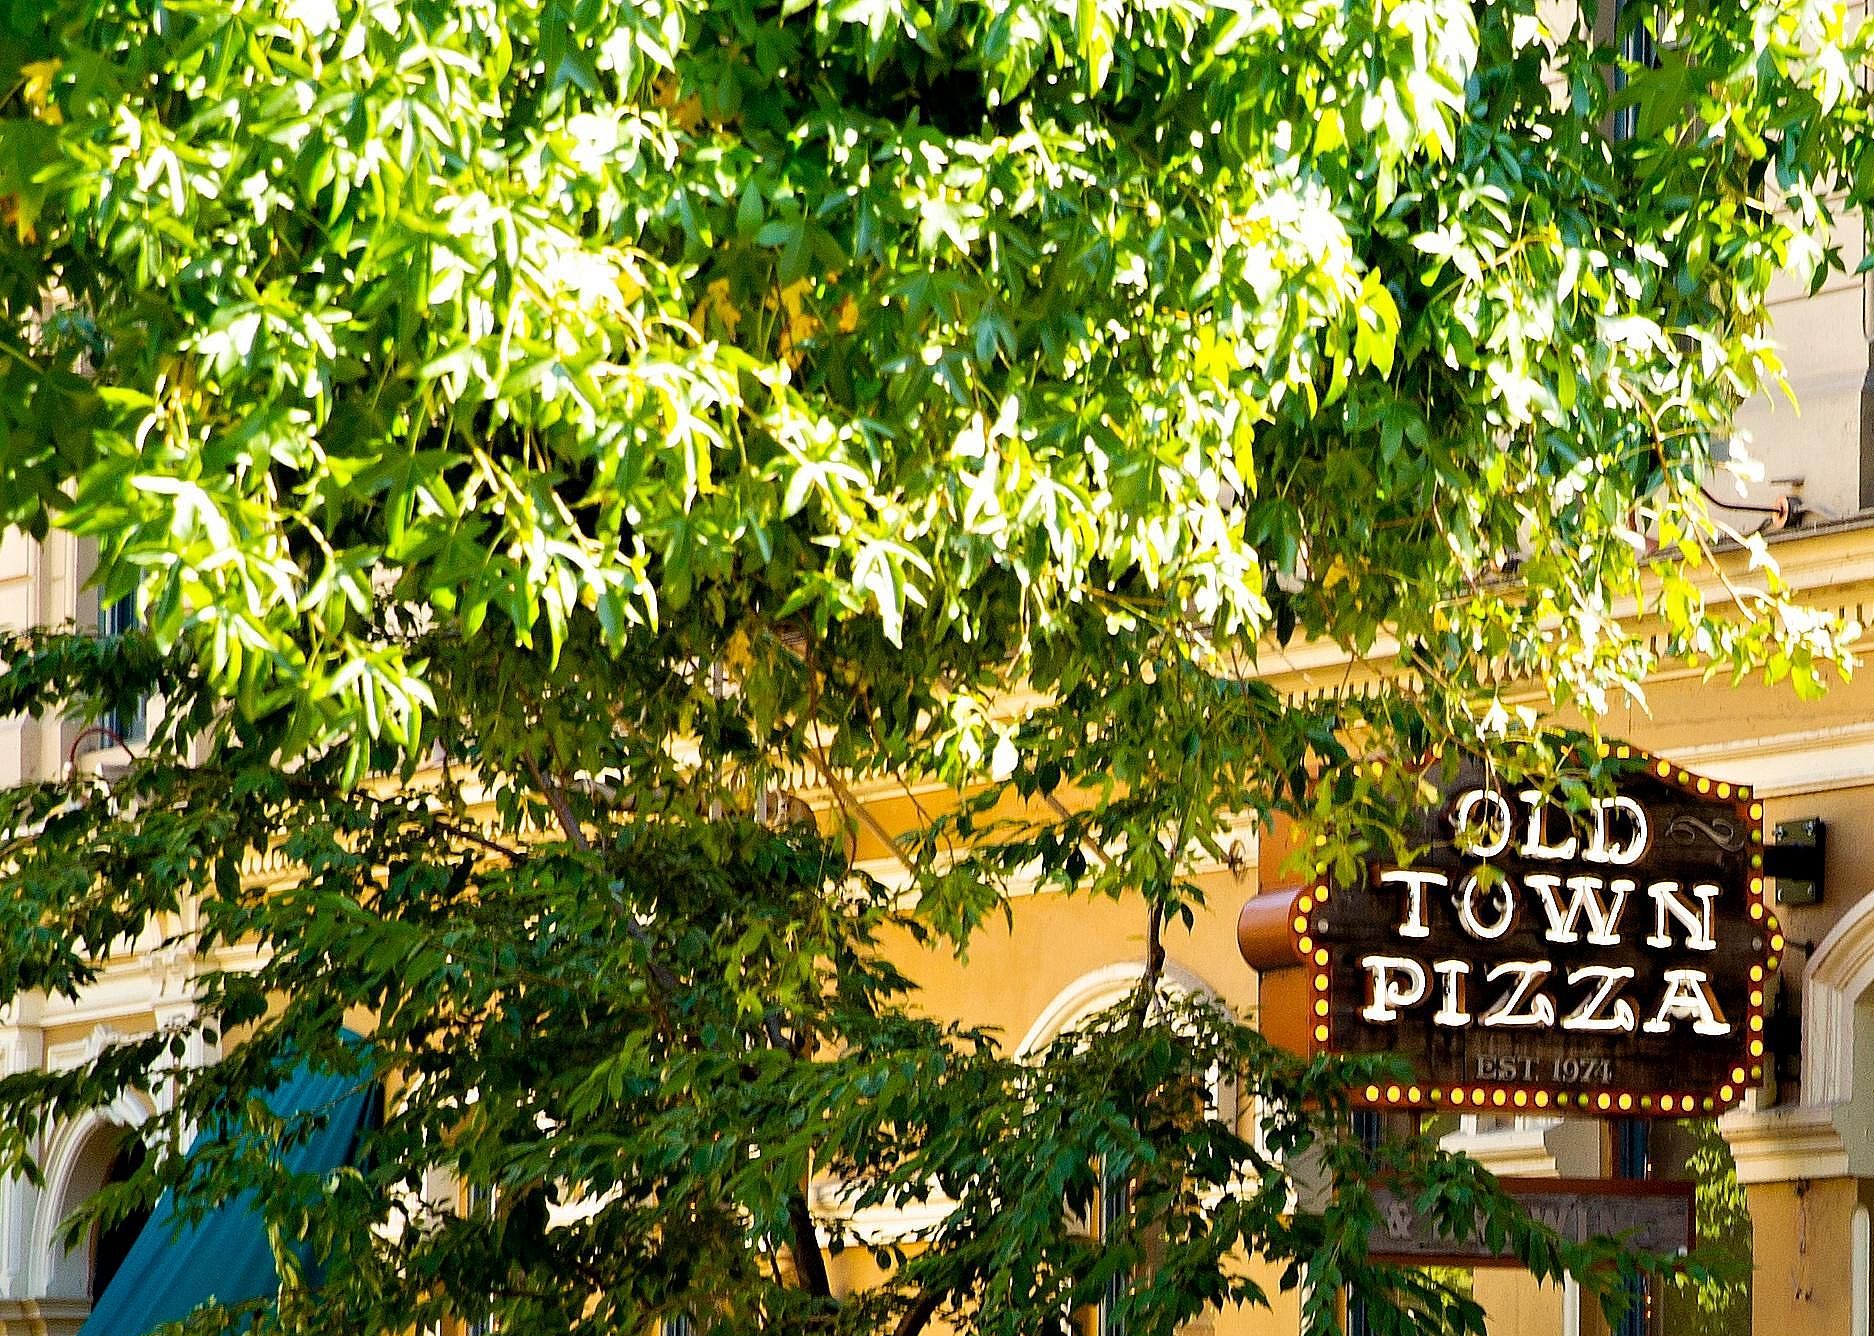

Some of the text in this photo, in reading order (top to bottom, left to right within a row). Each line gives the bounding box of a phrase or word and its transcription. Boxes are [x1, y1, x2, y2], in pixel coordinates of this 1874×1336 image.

[1455, 788, 1650, 866] OLD
[1379, 869, 1721, 952] TOWN
[1360, 953, 1732, 1037] PIZZA
[1475, 1055, 1613, 1083] EST. 1974
